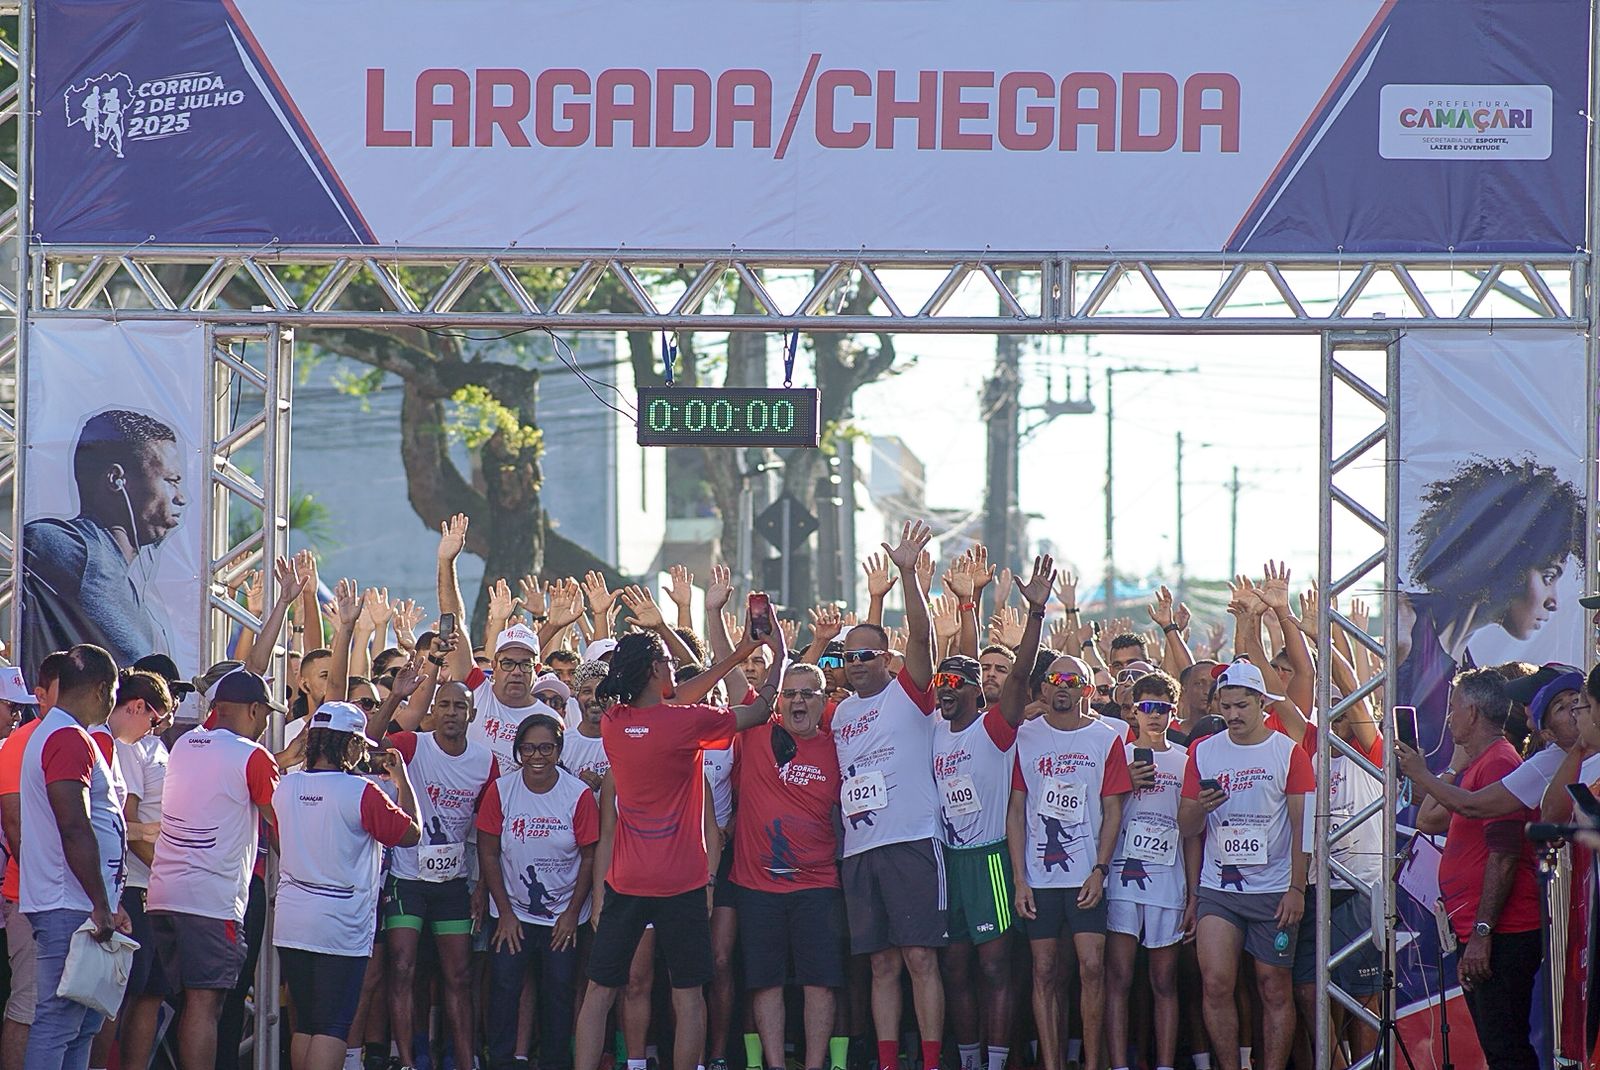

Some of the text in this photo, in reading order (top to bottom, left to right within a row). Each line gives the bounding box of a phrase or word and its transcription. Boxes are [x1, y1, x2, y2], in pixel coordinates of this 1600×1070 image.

[137, 76, 225, 98] CORRIDA
[133, 90, 246, 115] 2 DE JULHO
[1428, 100, 1510, 108] PREFEITURA
[127, 112, 192, 138] 2025
[1399, 108, 1532, 133] CAMAÇARI
[1475, 137, 1509, 145] ESPORTE,
[649, 399, 794, 432] 0:00:00
[792, 764, 821, 775] CORRIDA
[1072, 760, 1096, 768] JULHO
[806, 773, 827, 782] JULHO
[1153, 773, 1177, 781] ORRIDA
[1236, 769, 1266, 777] CORRIDA
[787, 775, 809, 786] 2025
[1231, 781, 1253, 791] 2025
[847, 784, 877, 802] 1921
[946, 787, 973, 805] 1409
[1046, 790, 1078, 809] 0186
[526, 830, 550, 838] 2025
[1133, 835, 1169, 853] 0724
[1224, 839, 1259, 853] 0846
[426, 856, 457, 871] 0324
